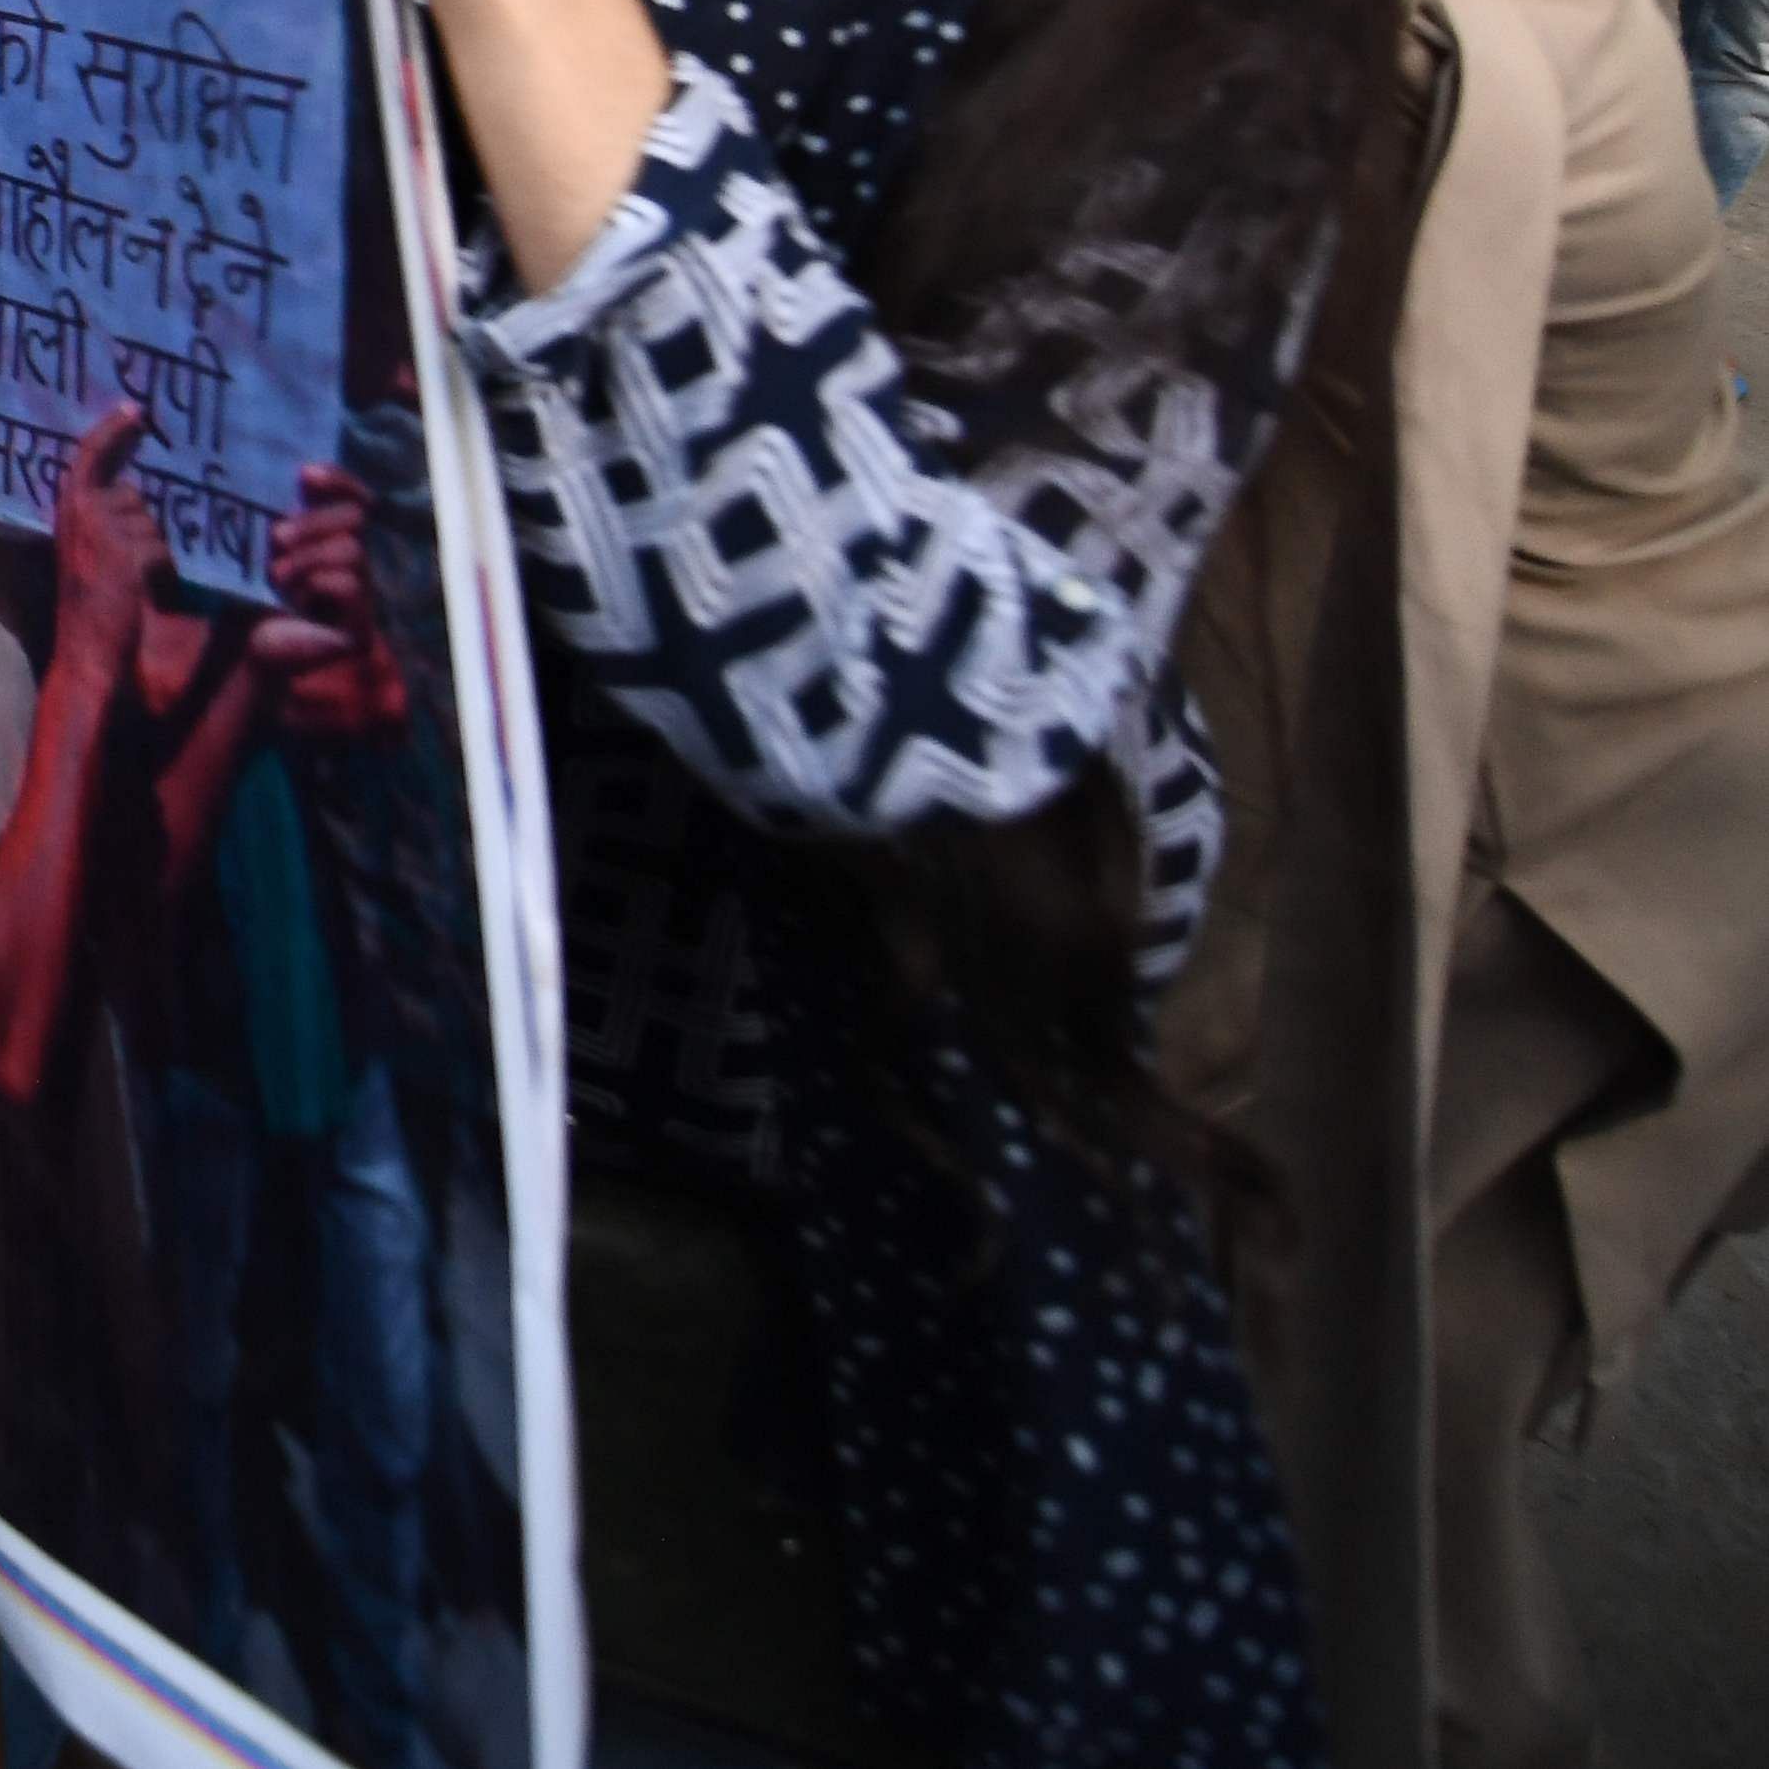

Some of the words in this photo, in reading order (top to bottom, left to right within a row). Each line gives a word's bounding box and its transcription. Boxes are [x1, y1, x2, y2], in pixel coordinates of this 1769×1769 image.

[74, 11, 310, 184] सुरक्षित
[123, 218, 176, 309] न
[177, 176, 290, 341] देने
